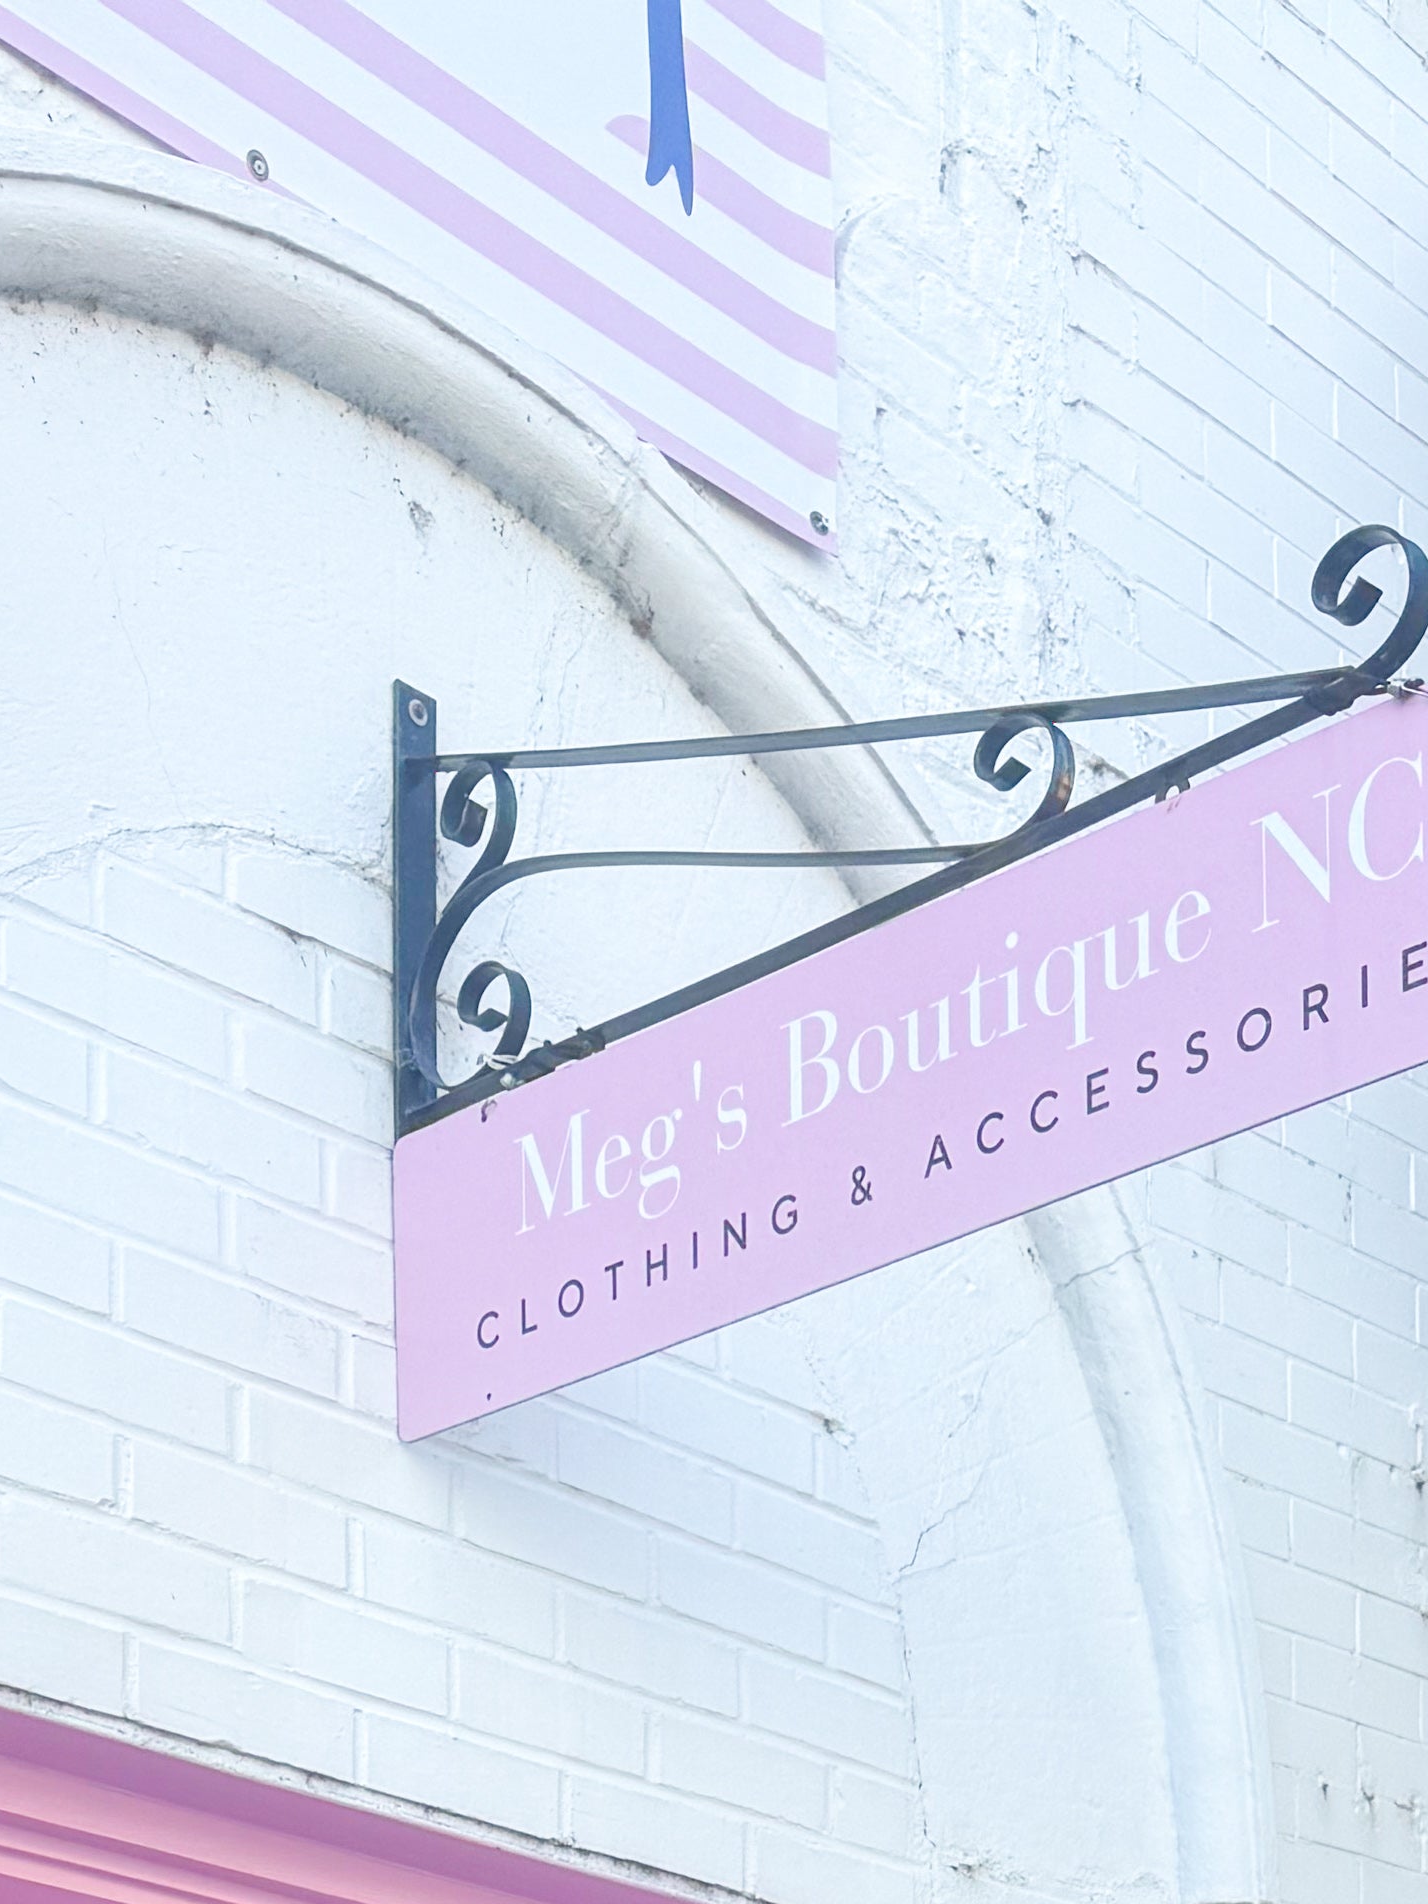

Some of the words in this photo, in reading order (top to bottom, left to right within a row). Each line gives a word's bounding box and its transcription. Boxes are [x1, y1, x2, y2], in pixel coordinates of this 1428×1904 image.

[513, 1062, 749, 1237] Meg's
[779, 890, 1213, 1128] Boutique
[1249, 756, 1427, 931] NC
[475, 1194, 801, 1352] CLOTHING
[849, 1164, 873, 1207] &
